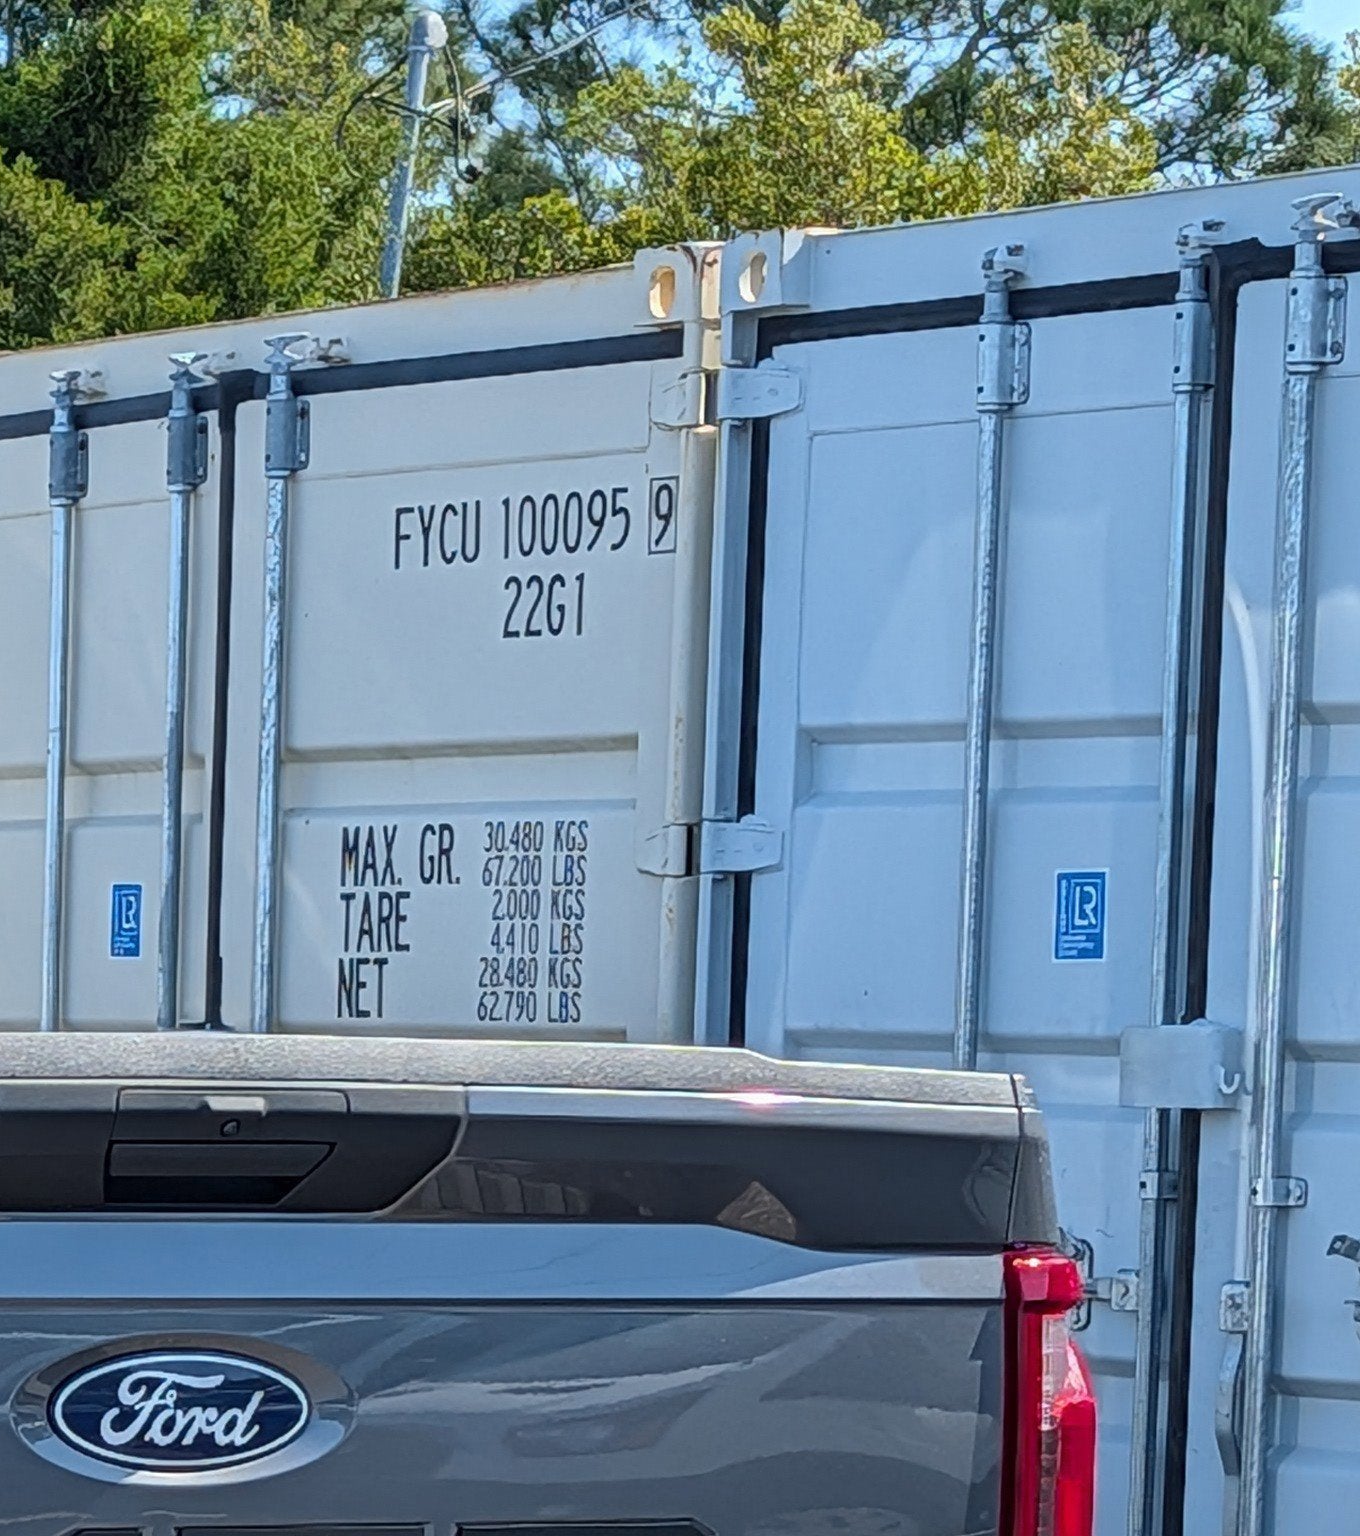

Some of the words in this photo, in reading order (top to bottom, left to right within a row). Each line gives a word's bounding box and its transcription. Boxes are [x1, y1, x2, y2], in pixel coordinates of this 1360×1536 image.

[394, 500, 481, 570] FYCU
[502, 487, 630, 559] 100095
[653, 483, 674, 549] 9
[502, 572, 585, 638] 22G1
[419, 823, 460, 885] GR.
[553, 820, 589, 854] KGS
[552, 853, 587, 887] LBS
[340, 891, 411, 953] TARE
[551, 889, 585, 922] KGS
[549, 922, 584, 955] LBS
[336, 957, 389, 1022] NET
[548, 956, 582, 989] KGS
[547, 991, 582, 1023] LBS
[100, 1370, 265, 1446] Ford
